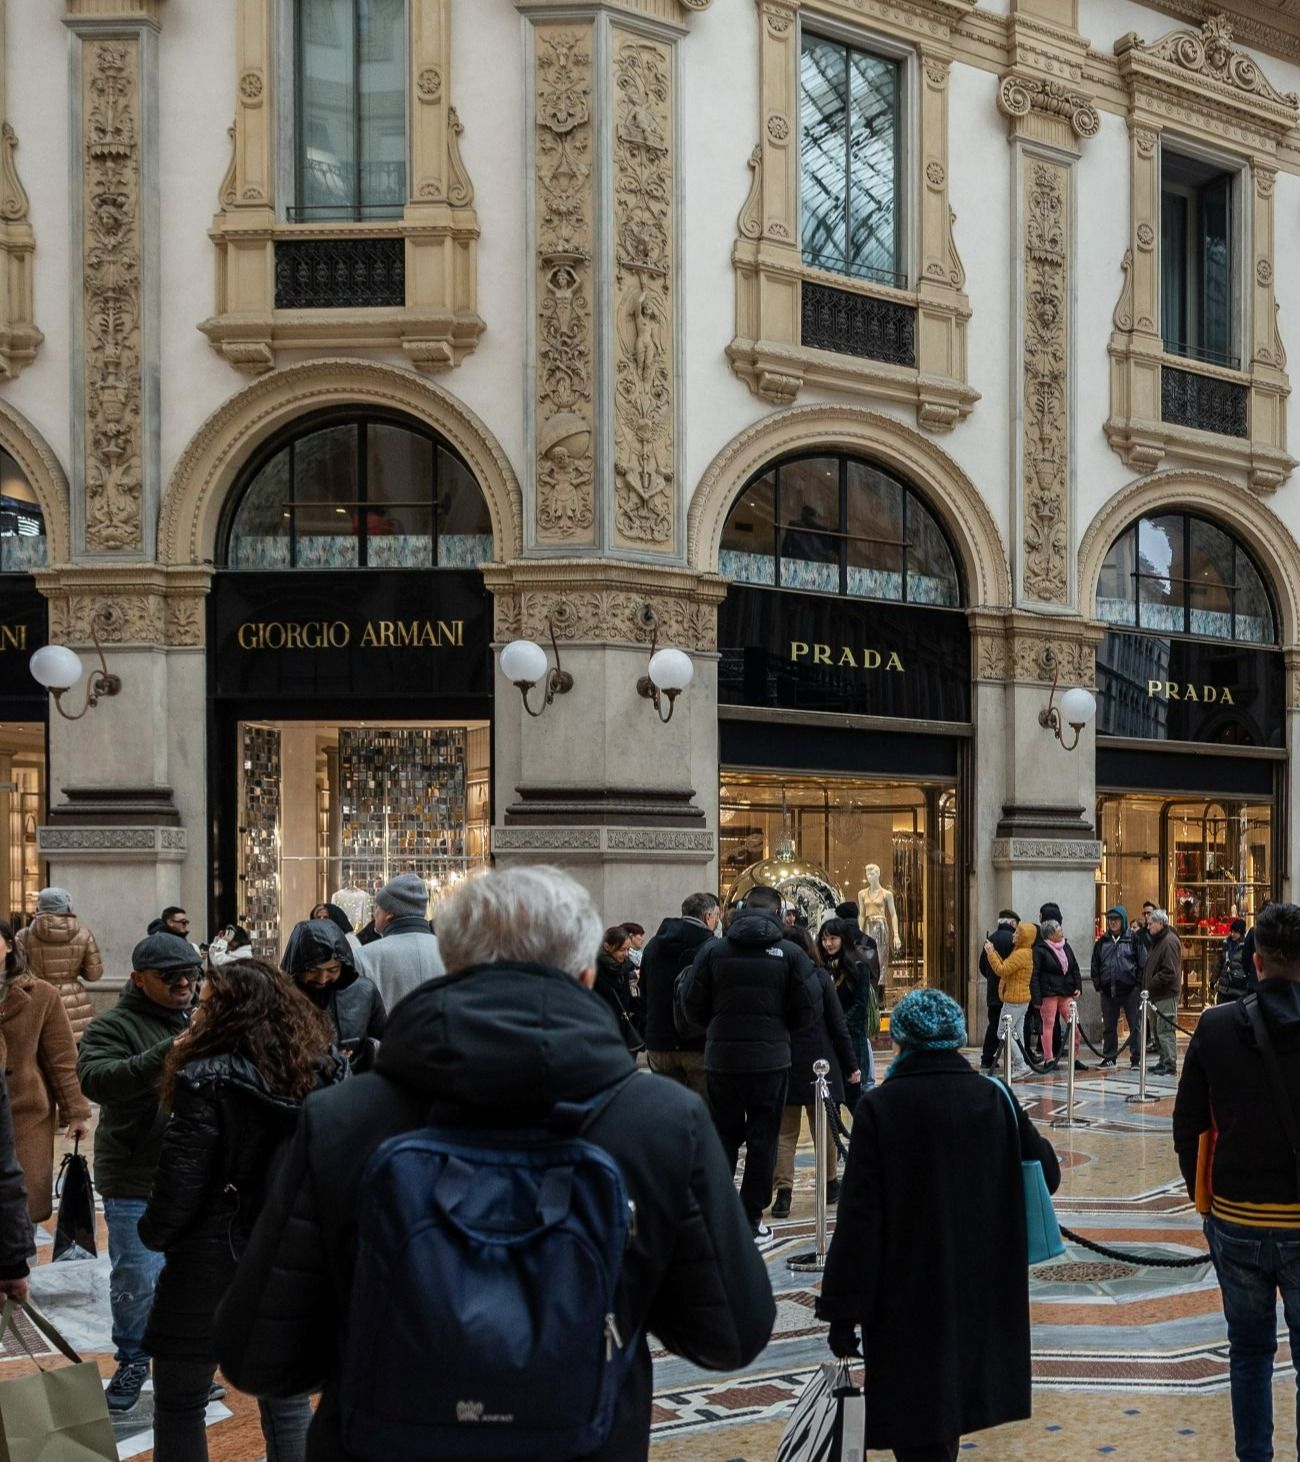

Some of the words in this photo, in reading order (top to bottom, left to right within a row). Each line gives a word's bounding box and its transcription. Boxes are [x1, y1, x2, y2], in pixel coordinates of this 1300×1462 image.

[237, 621, 350, 649] GIORGIO
[360, 620, 464, 647] ARMANI
[791, 641, 905, 672] PRADA
[1148, 680, 1234, 704] PRADA
